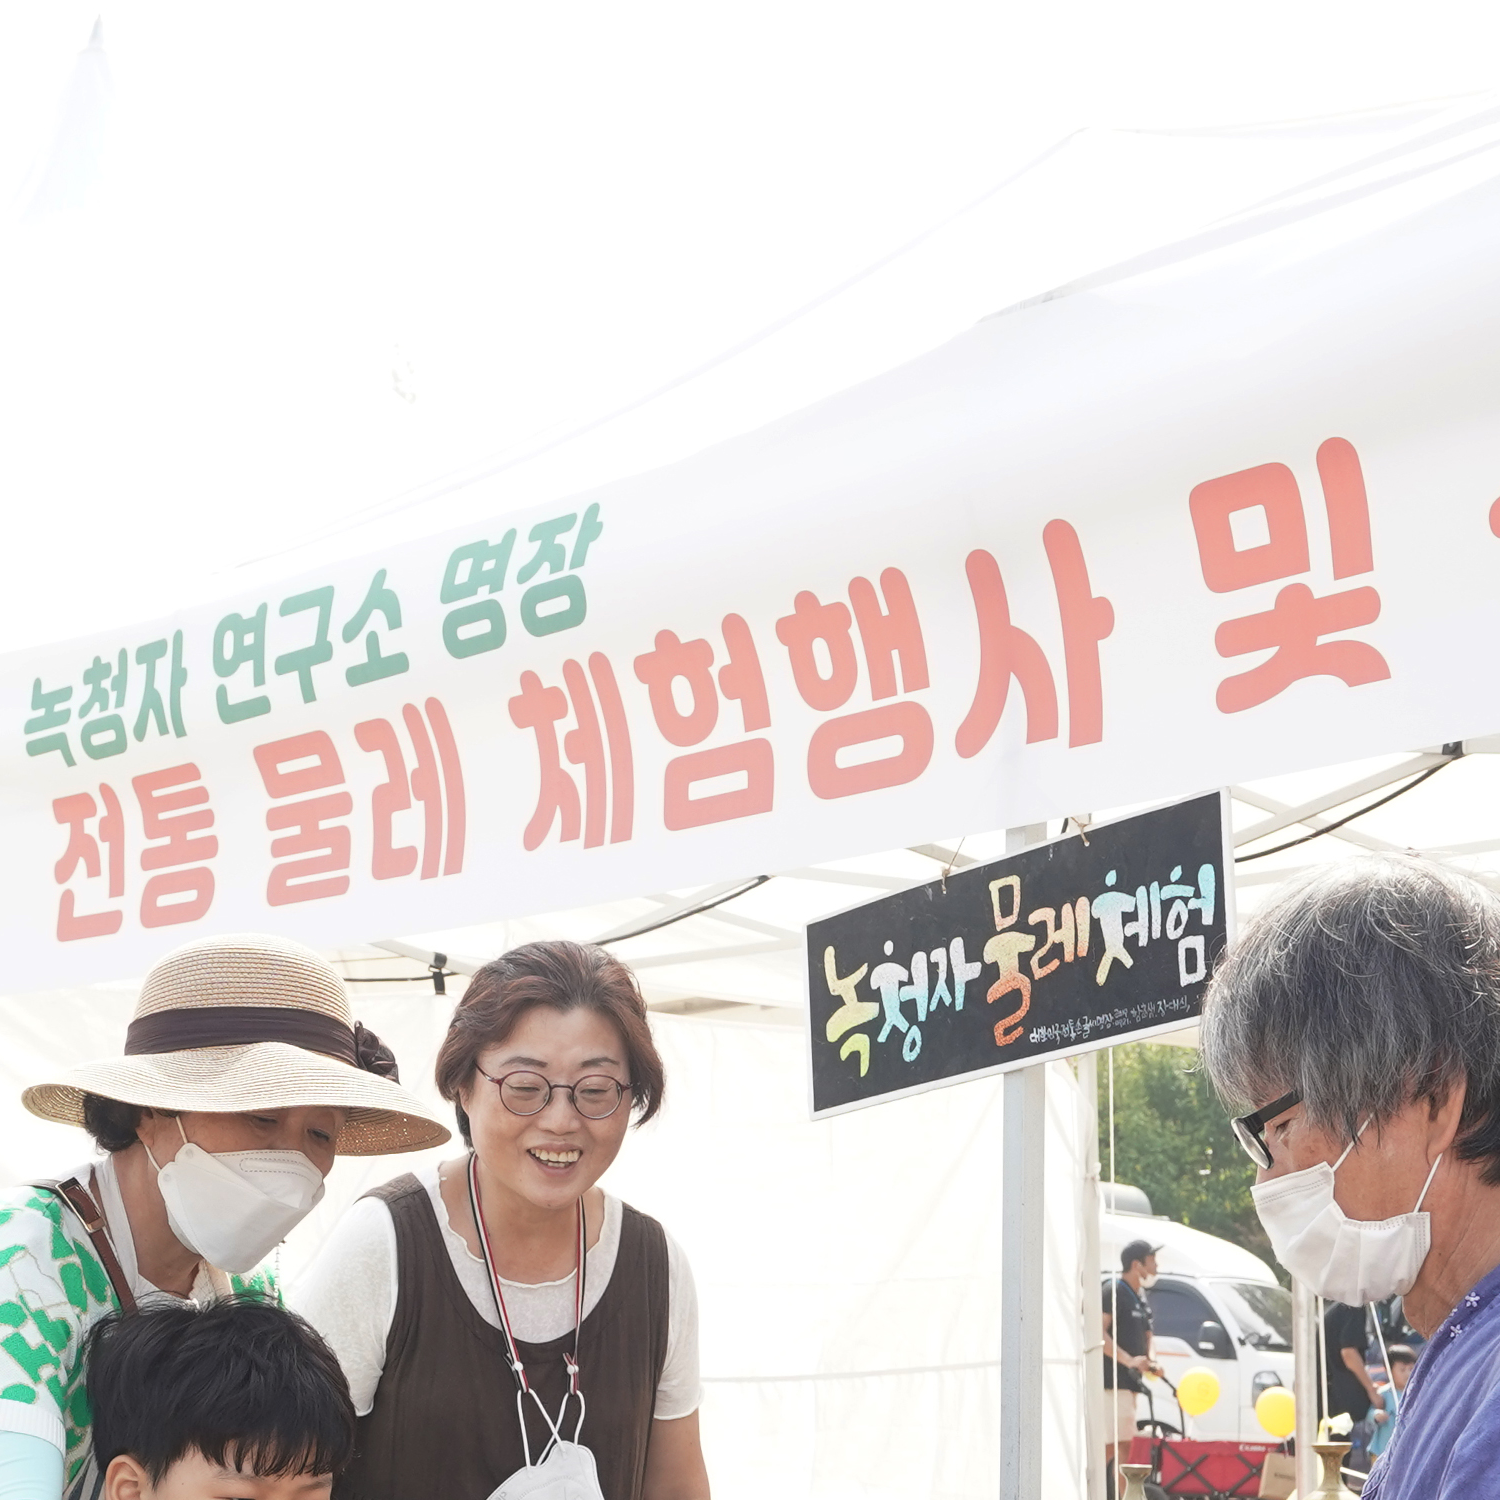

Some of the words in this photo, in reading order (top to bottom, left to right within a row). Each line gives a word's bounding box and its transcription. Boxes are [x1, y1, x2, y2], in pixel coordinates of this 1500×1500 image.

[23, 629, 188, 767] 녹청자
[212, 568, 410, 724] 연구소
[439, 502, 604, 659] 명장
[52, 762, 219, 942] 전통
[253, 696, 465, 907] 물레
[508, 518, 1115, 851] 체험행사
[1188, 436, 1391, 714] 및
[824, 937, 982, 1077] 녹청자
[983, 875, 1091, 1046] 물레
[1091, 863, 1216, 987] 체험
